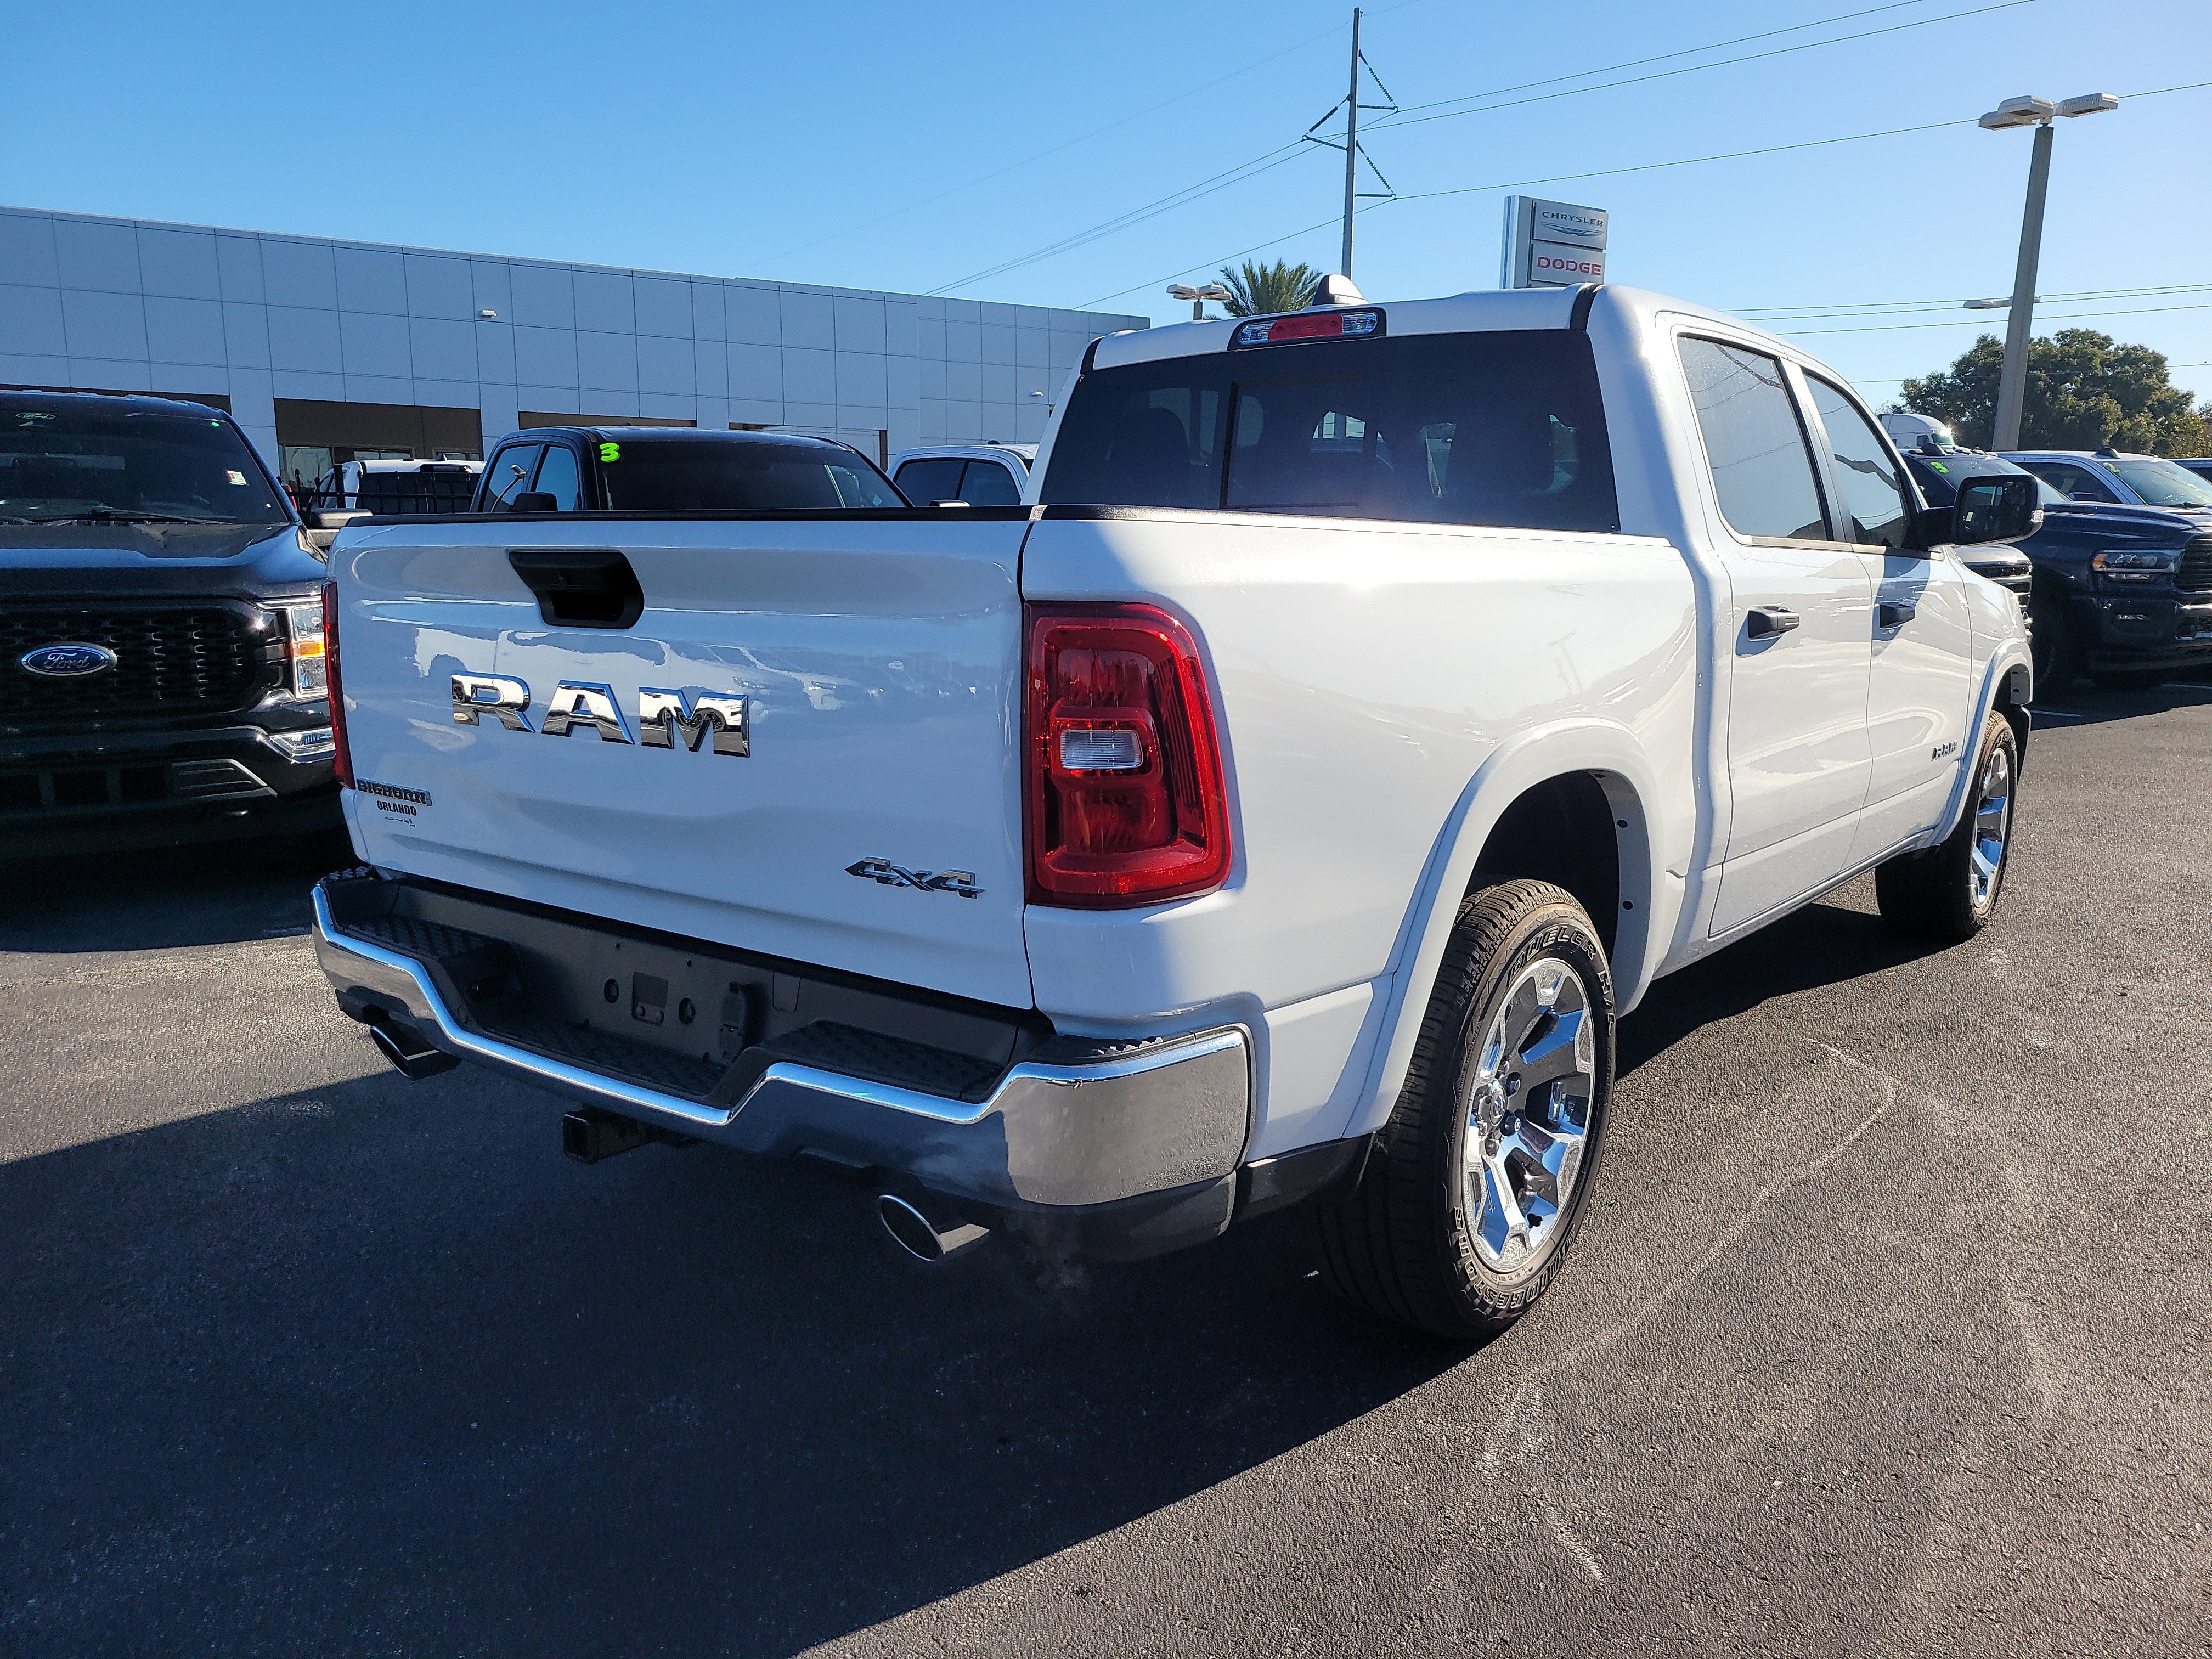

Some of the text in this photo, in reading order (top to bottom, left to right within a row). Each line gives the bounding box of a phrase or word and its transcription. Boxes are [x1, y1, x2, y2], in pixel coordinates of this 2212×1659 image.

[1542, 211, 1604, 227] CHRYSLER
[1538, 257, 1601, 275] DODGE
[600, 442, 620, 462] 3
[43, 652, 90, 669] Ford
[450, 670, 751, 758] RAM
[376, 800, 417, 816] ORLANDO
[1506, 925, 1598, 988] DUELER
